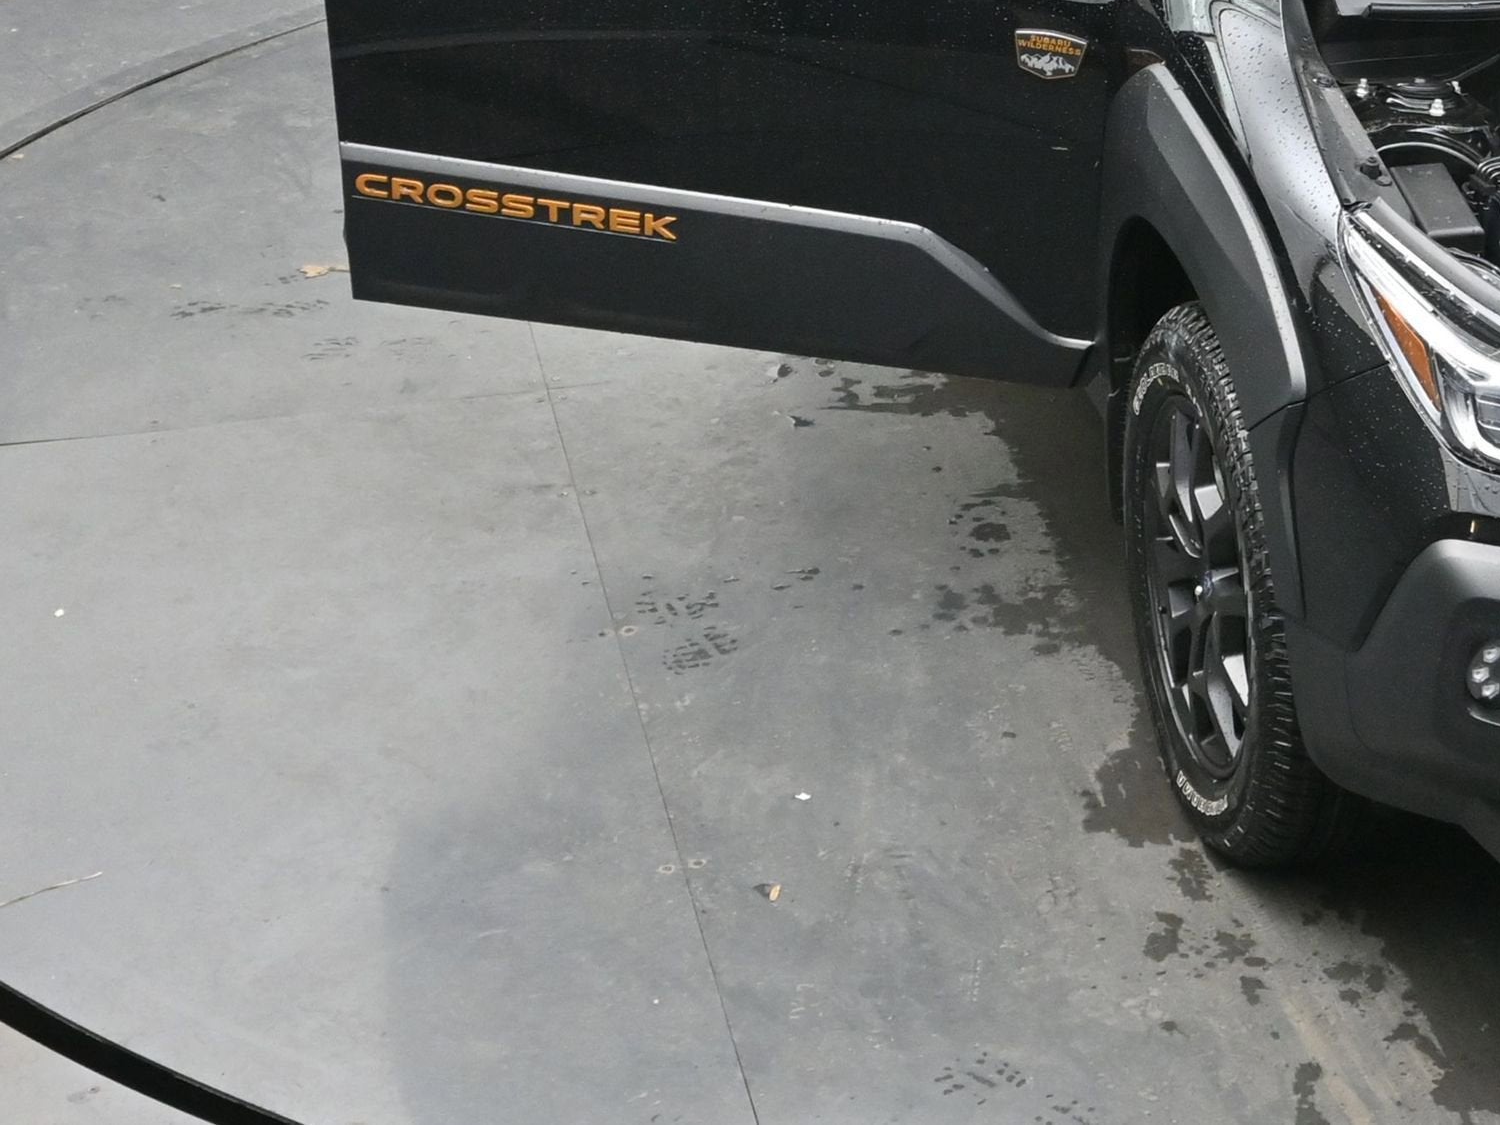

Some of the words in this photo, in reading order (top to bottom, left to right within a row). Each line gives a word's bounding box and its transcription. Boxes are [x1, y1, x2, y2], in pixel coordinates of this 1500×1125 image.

[1017, 38, 1082, 56] WILDERNESS
[1030, 34, 1072, 47] SUBARU
[354, 172, 679, 241] CROSSTREK
